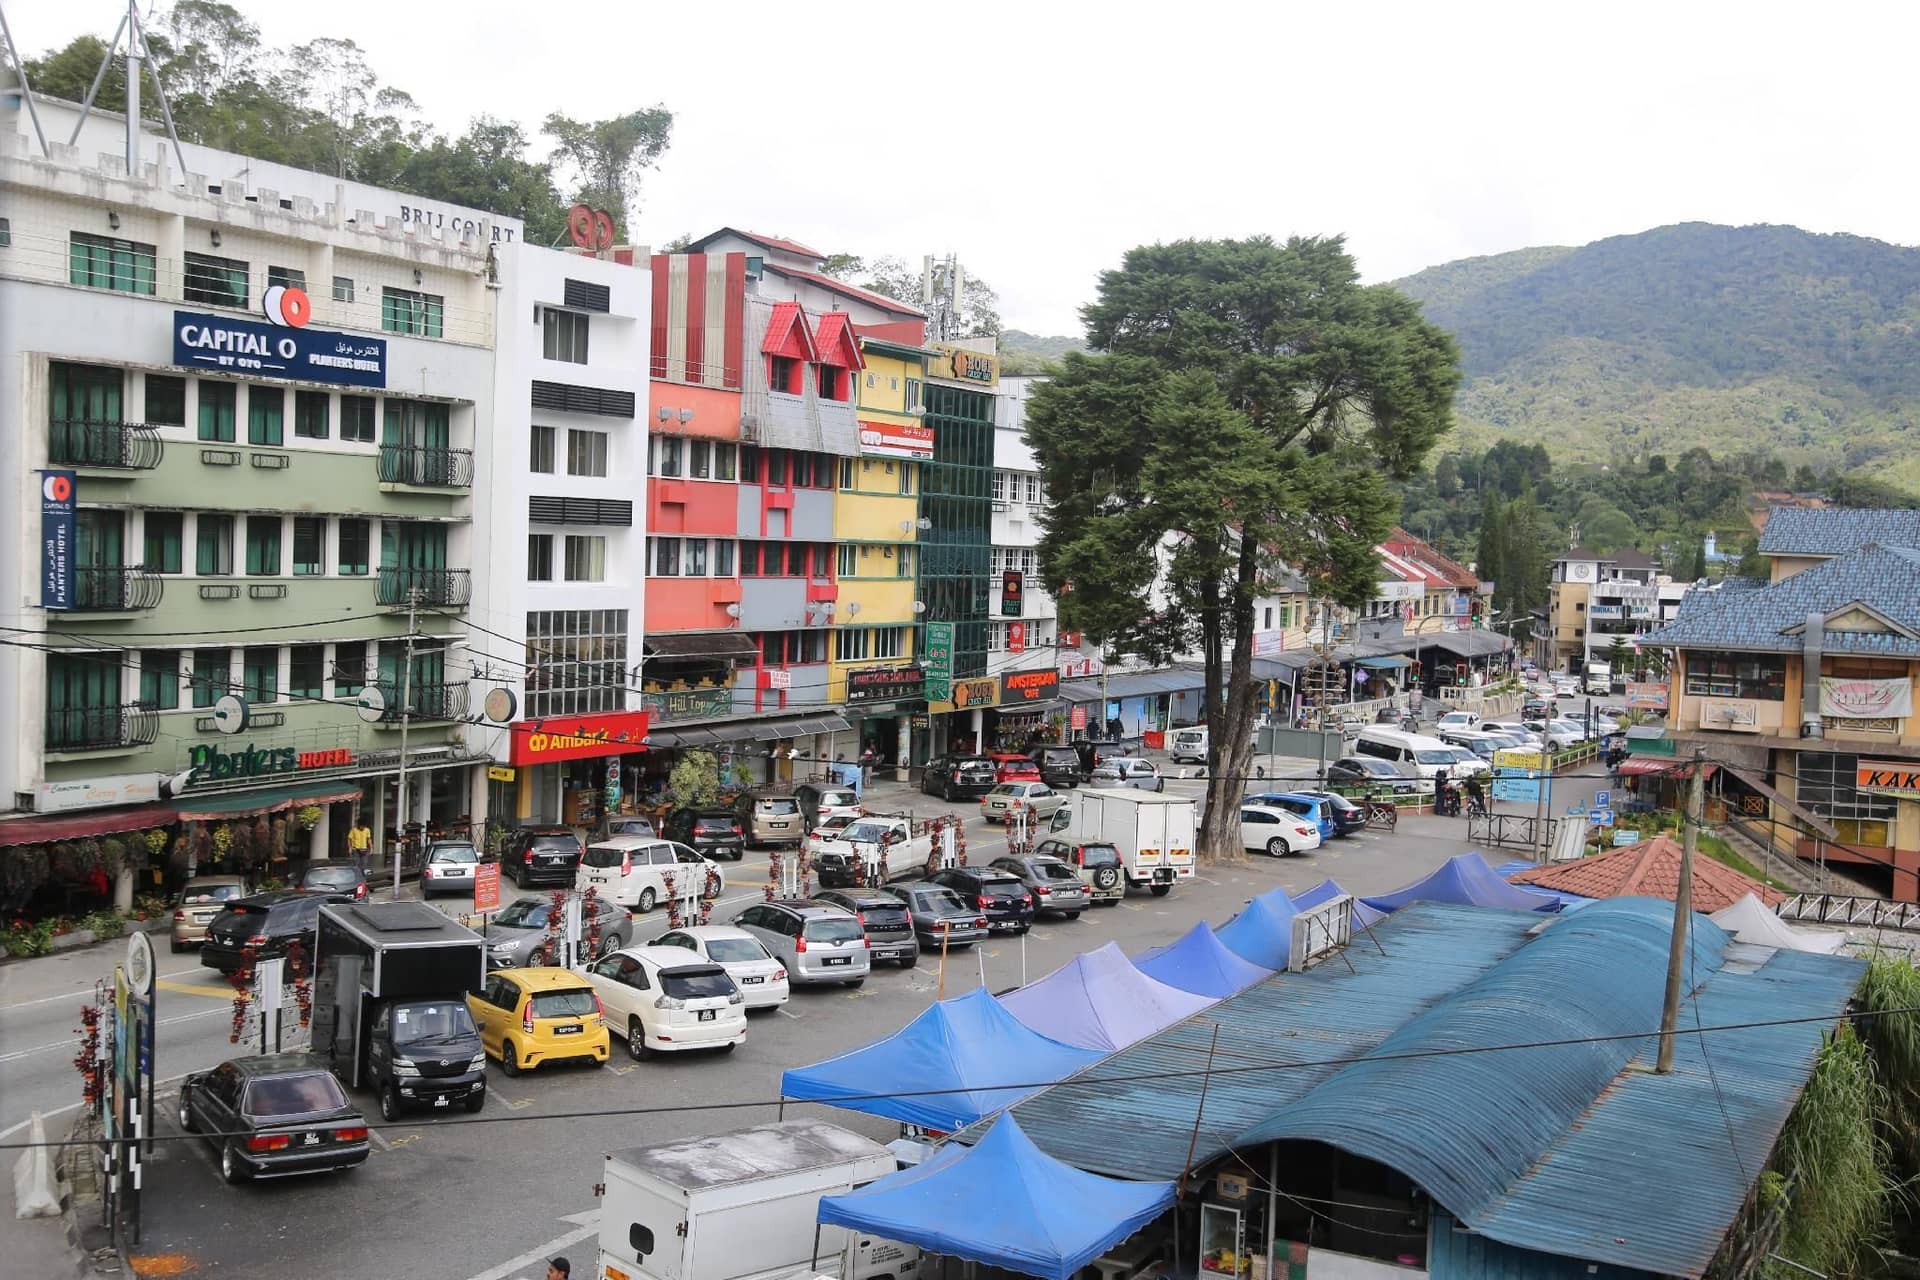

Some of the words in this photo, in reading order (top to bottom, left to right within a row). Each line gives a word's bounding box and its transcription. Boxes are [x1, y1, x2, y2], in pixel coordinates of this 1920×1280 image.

[400, 205, 444, 229] BRIJ
[180, 325, 271, 357] CAPITAL
[278, 338, 297, 359] O
[218, 355, 235, 366] BY
[309, 353, 354, 370] PLANTERS
[57, 523, 66, 553] HOTEL
[57, 555, 66, 603] PLANTERS
[1007, 671, 1057, 689] AMSTERDAM
[669, 694, 687, 712] Hill
[688, 695, 706, 713] Top
[1024, 688, 1040, 699] CAFE
[550, 728, 609, 750] AmBank
[188, 743, 296, 781] Planters
[300, 748, 353, 769] HOTEL
[1599, 793, 1607, 804] P
